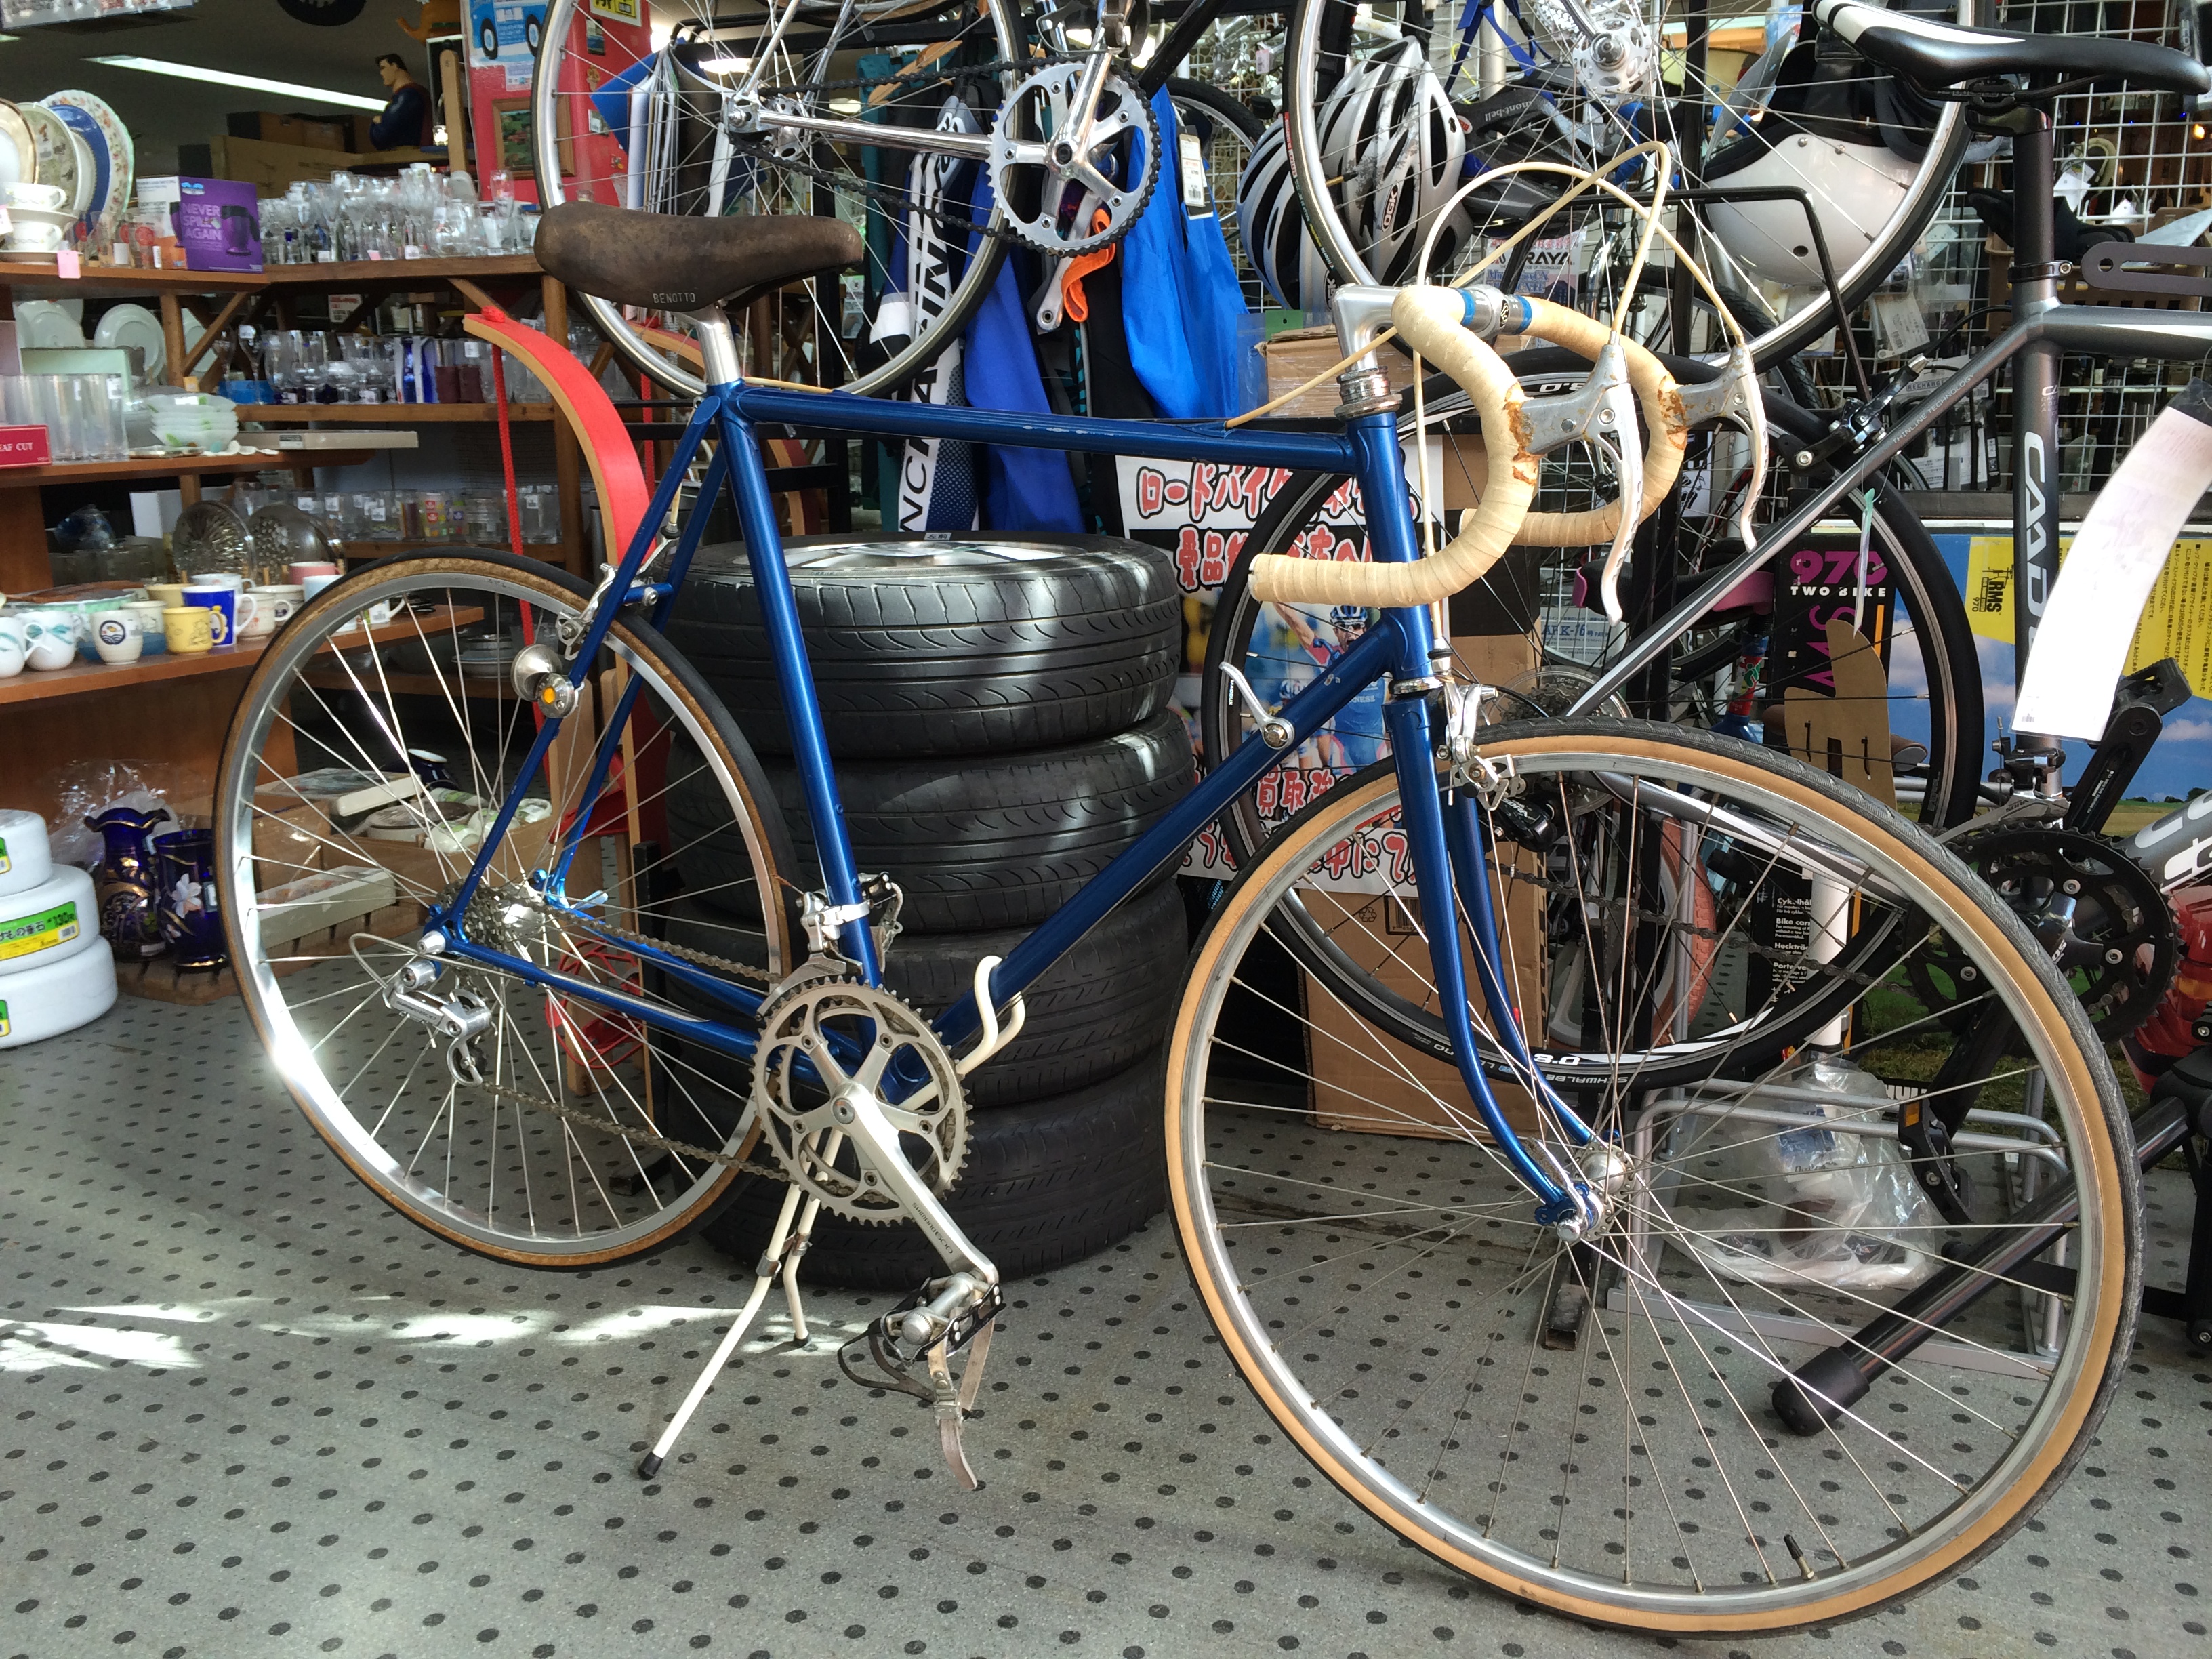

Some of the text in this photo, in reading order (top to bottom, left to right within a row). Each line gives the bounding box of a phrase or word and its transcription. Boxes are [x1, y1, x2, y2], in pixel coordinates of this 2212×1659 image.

[182, 203, 221, 217] NEVER
[1384, 189, 1398, 227] OGK
[185, 228, 222, 241] AGAIN
[1525, 251, 1573, 265] RAYA
[653, 292, 696, 304] BENOTTO
[1892, 413, 1927, 444] THINLINE
[1790, 550, 1889, 586] 970
[1790, 586, 1887, 598] TWO BIKE
[1986, 581, 2005, 613] RMS
